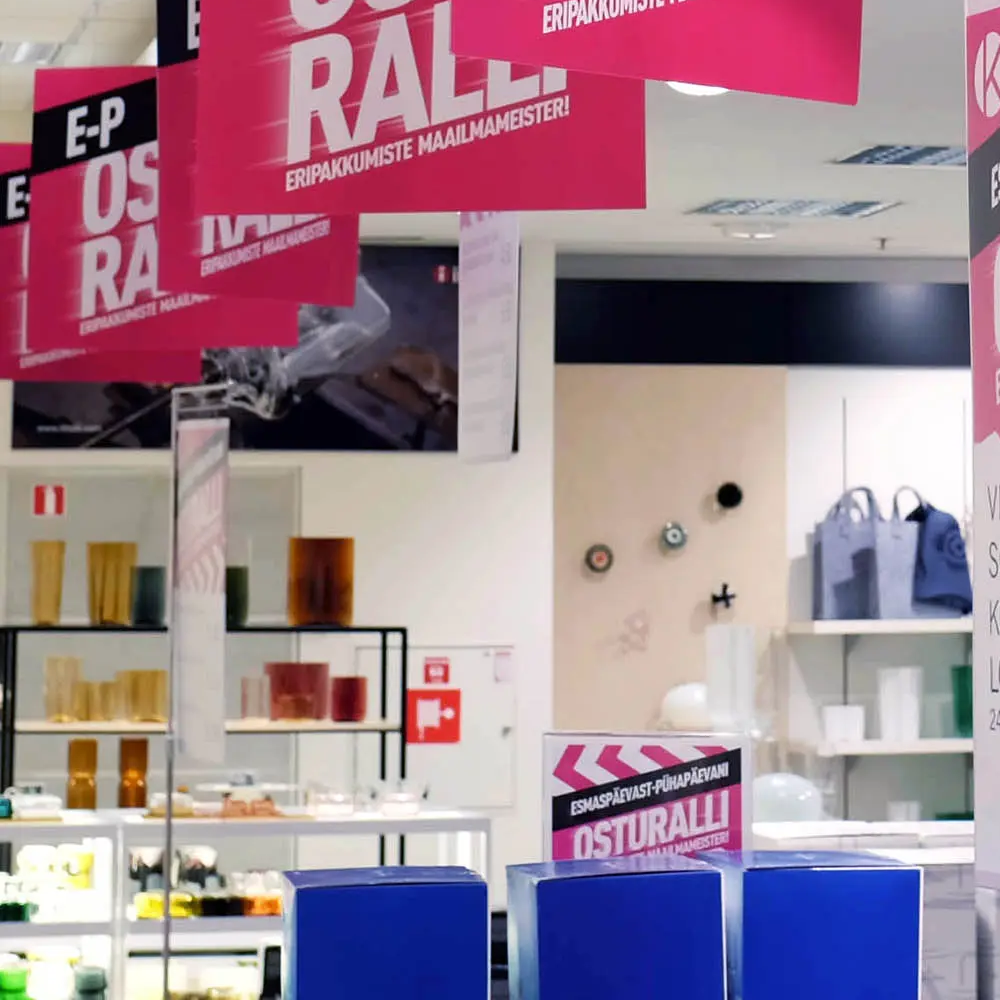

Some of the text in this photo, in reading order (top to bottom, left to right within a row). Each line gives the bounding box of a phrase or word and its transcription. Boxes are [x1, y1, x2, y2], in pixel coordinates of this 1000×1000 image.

[65, 96, 126, 160] E-P
[285, 96, 570, 192] ERIPAKKUMISTE MAAILMAMEISTER!
[571, 761, 730, 817] ESMASPÄEVAST-PÜHAPÄEVANI
[573, 790, 730, 860] OSTURALLI
